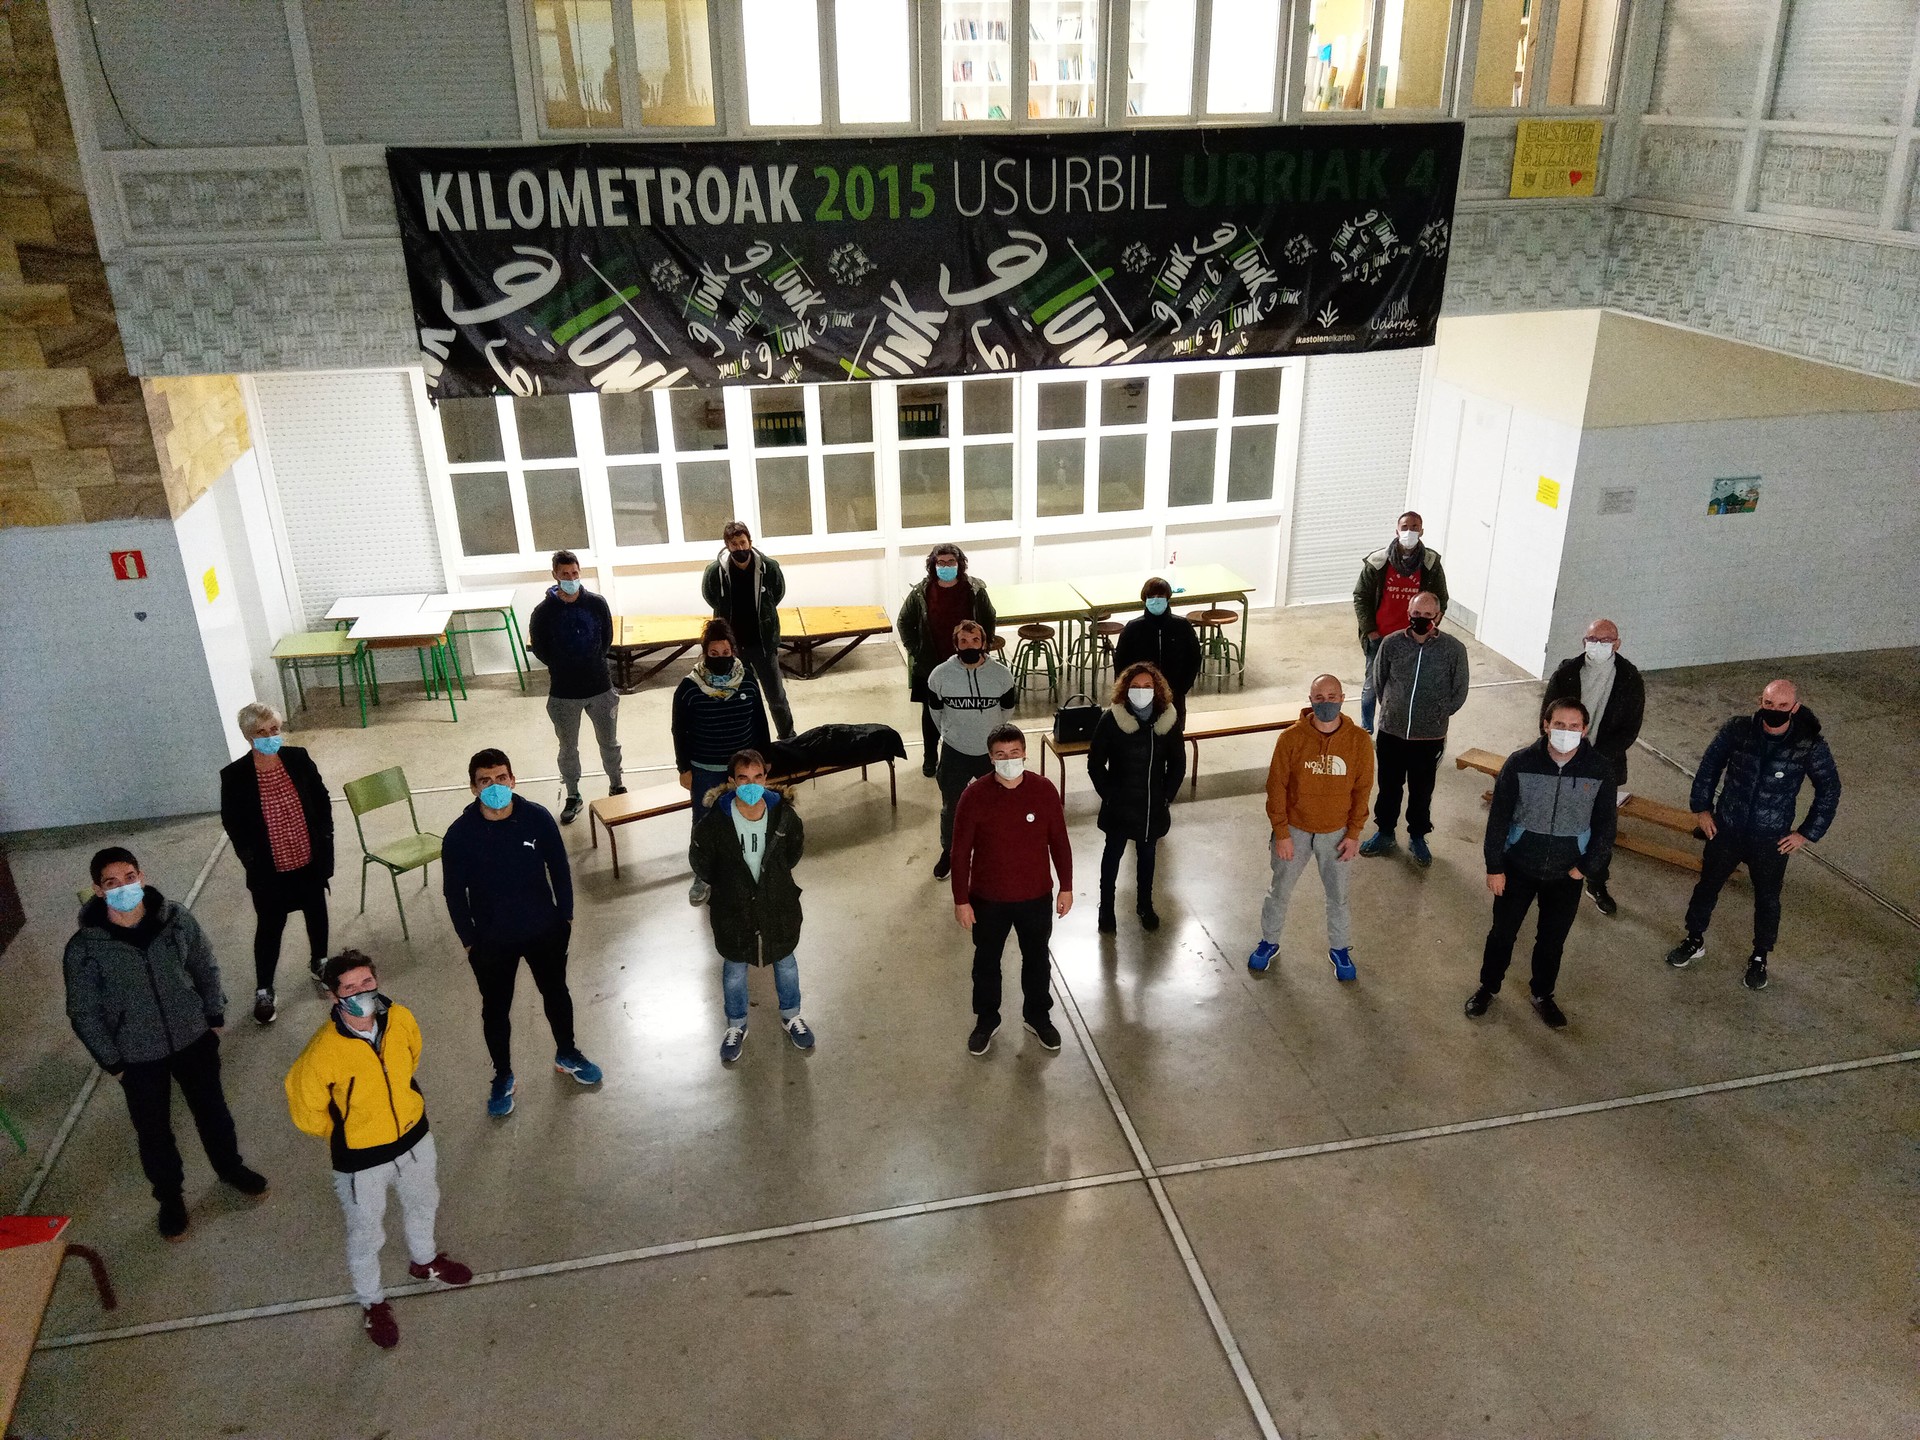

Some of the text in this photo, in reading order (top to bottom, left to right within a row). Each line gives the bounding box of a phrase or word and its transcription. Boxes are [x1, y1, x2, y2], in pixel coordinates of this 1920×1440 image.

[420, 148, 1437, 232] KILOMETROAK 2015 USURBIL URRIAK 4
[944, 698, 975, 708] CALVIN
